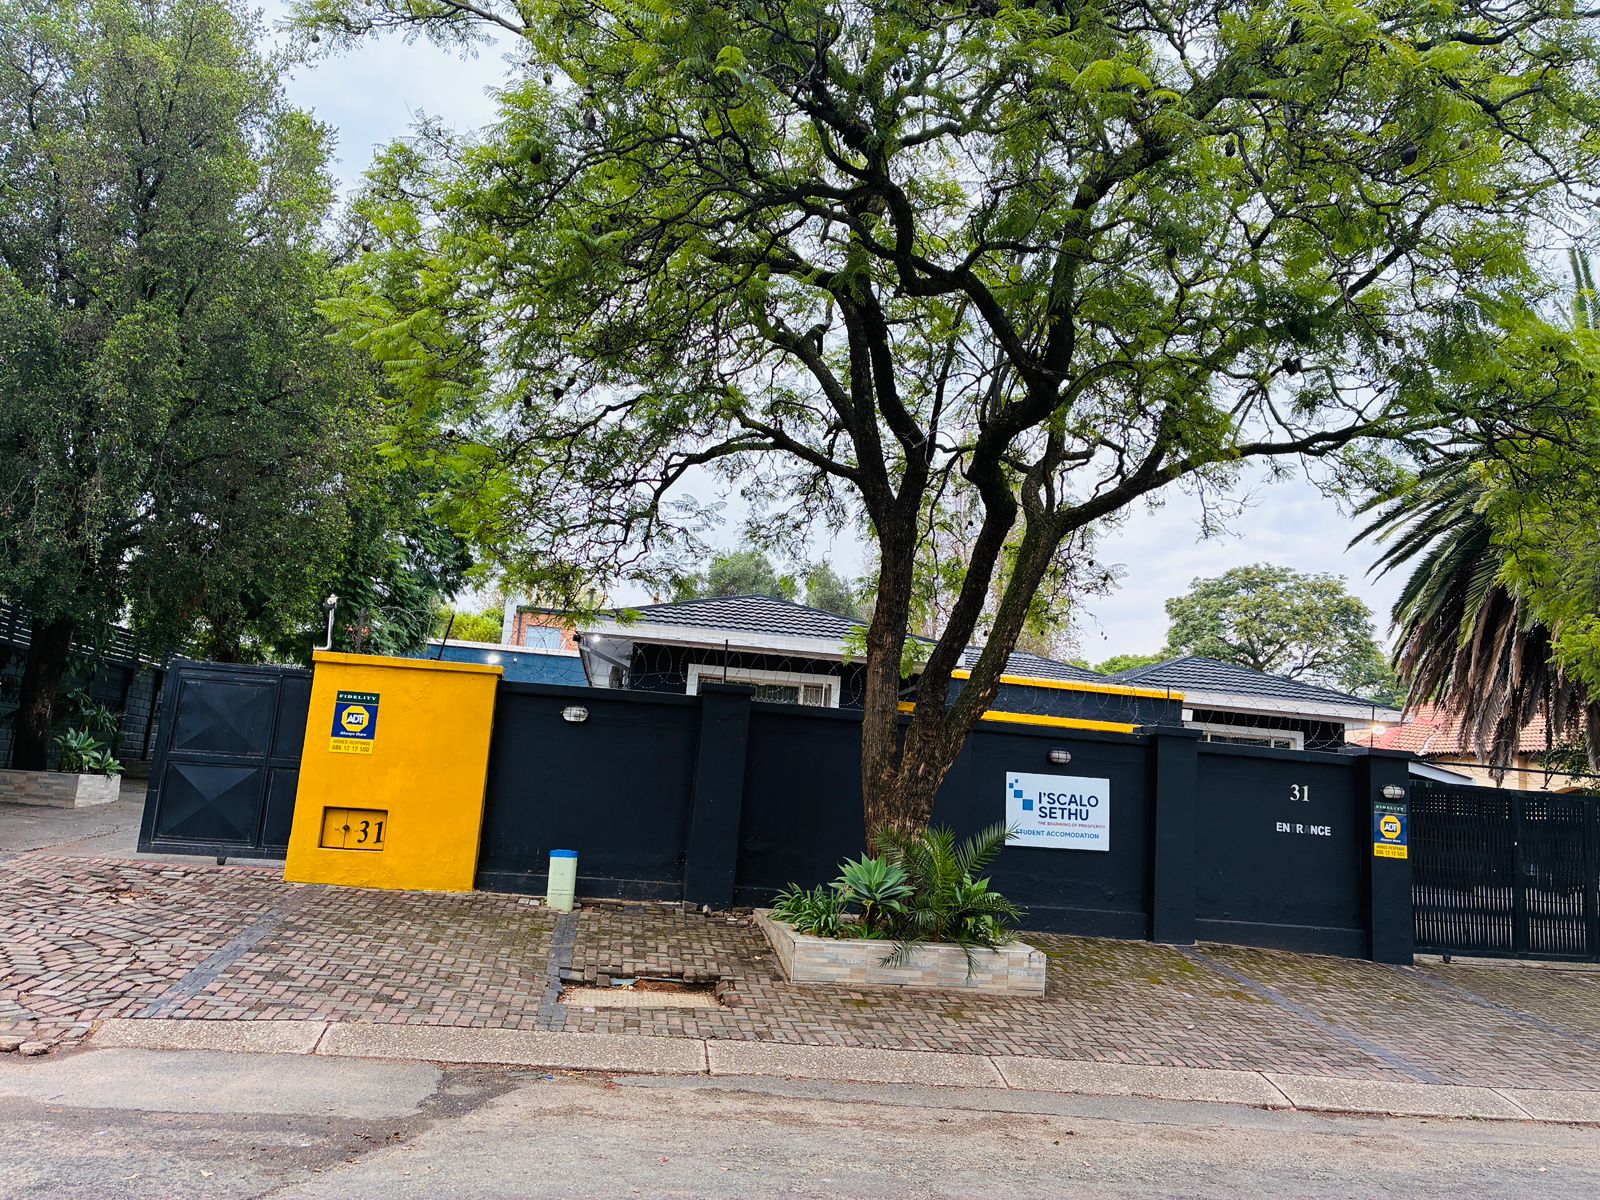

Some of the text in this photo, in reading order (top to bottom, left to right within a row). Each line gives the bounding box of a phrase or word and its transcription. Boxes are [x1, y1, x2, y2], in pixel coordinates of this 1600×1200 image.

[346, 714, 365, 724] ADT
[1038, 792, 1099, 808] I'SCALO
[1290, 784, 1310, 802] 31
[1038, 806, 1089, 821] SETHU
[357, 820, 384, 844] 31
[1046, 831, 1100, 839] ACCOMODATION
[1384, 823, 1397, 832] ADT
